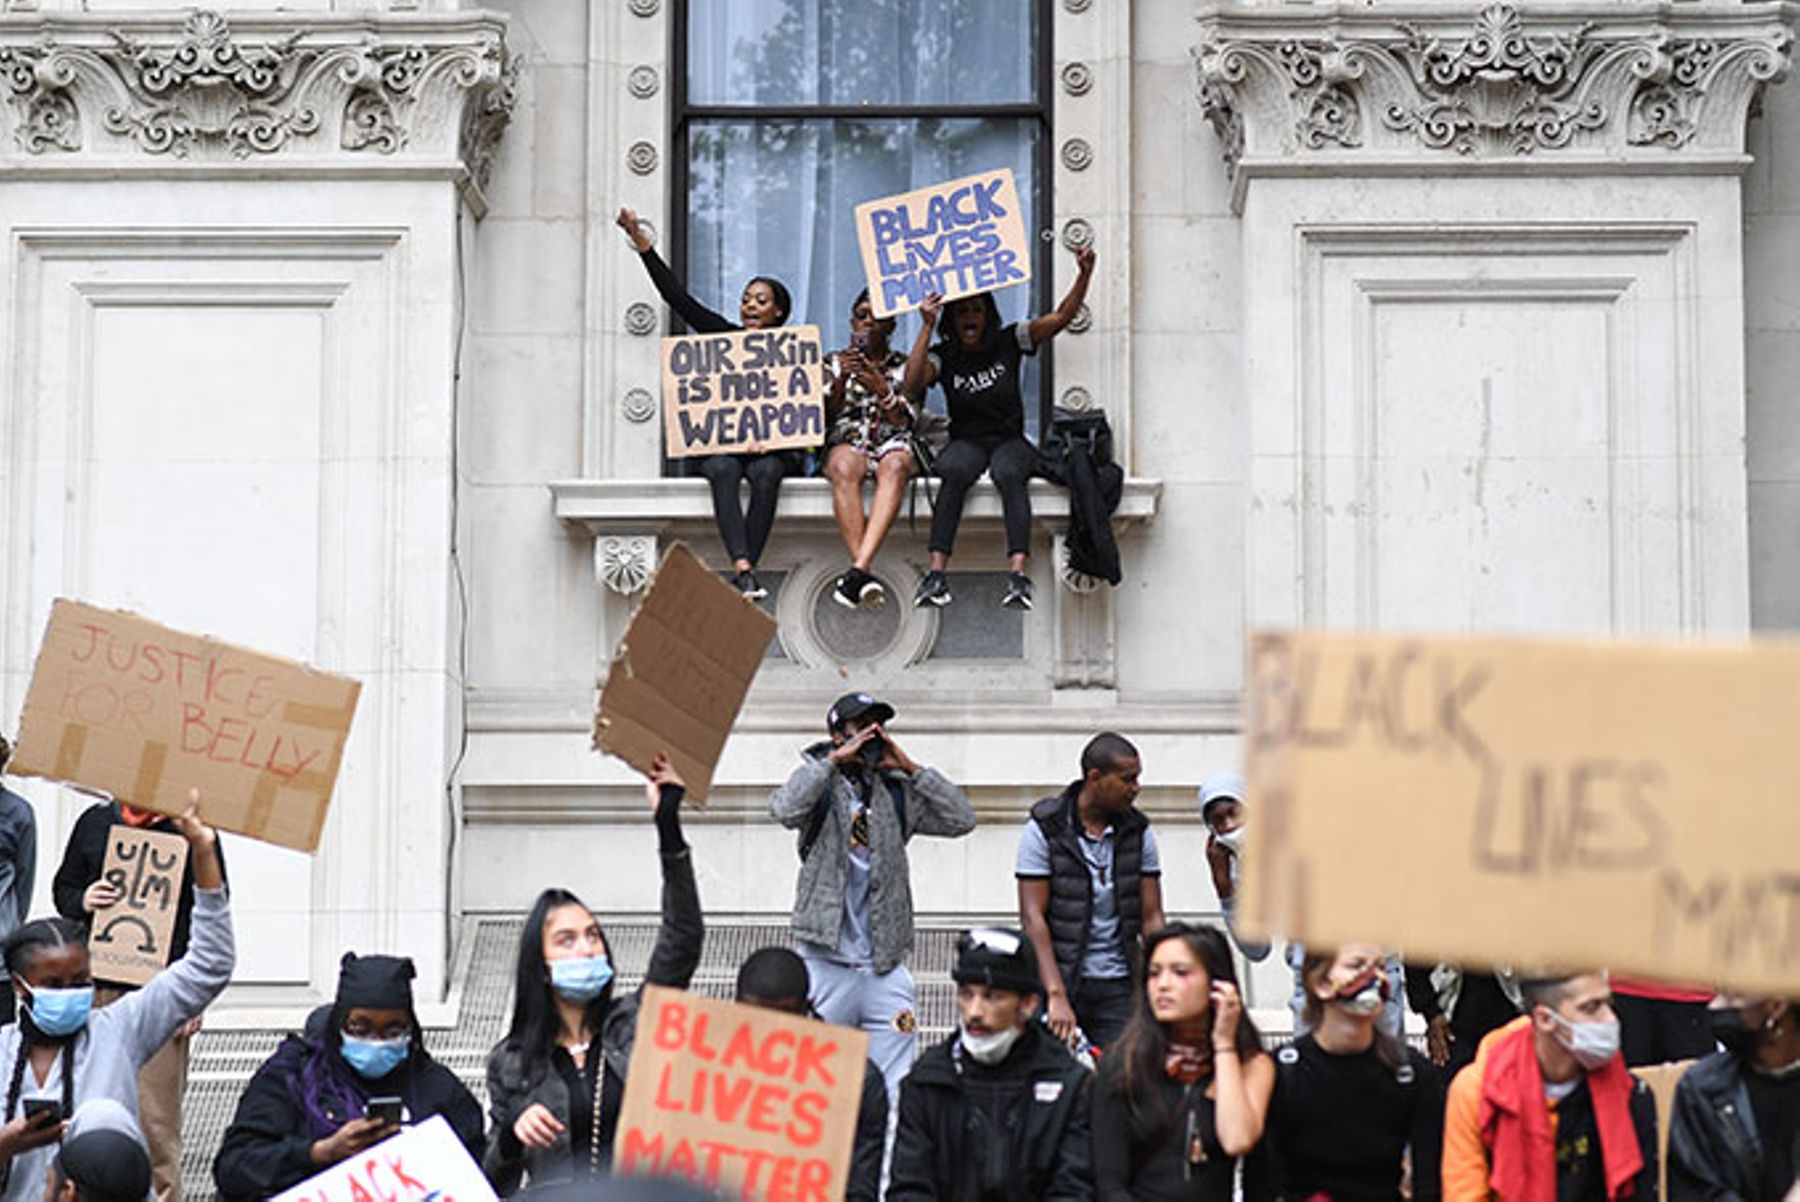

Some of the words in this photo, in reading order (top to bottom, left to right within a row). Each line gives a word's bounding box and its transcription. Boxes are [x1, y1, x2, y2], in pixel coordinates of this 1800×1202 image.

[870, 178, 1007, 246] BLACK
[882, 249, 1025, 311] MATTER
[670, 338, 735, 376] OUR
[788, 366, 811, 396] A
[70, 623, 275, 719] JUSTICE
[1251, 634, 1494, 766] BLACK
[58, 670, 156, 734] FOR
[182, 702, 321, 778] BELLY
[653, 1002, 840, 1088] BLACK
[654, 1061, 831, 1148] LIVES
[620, 1126, 834, 1202] MATTER
